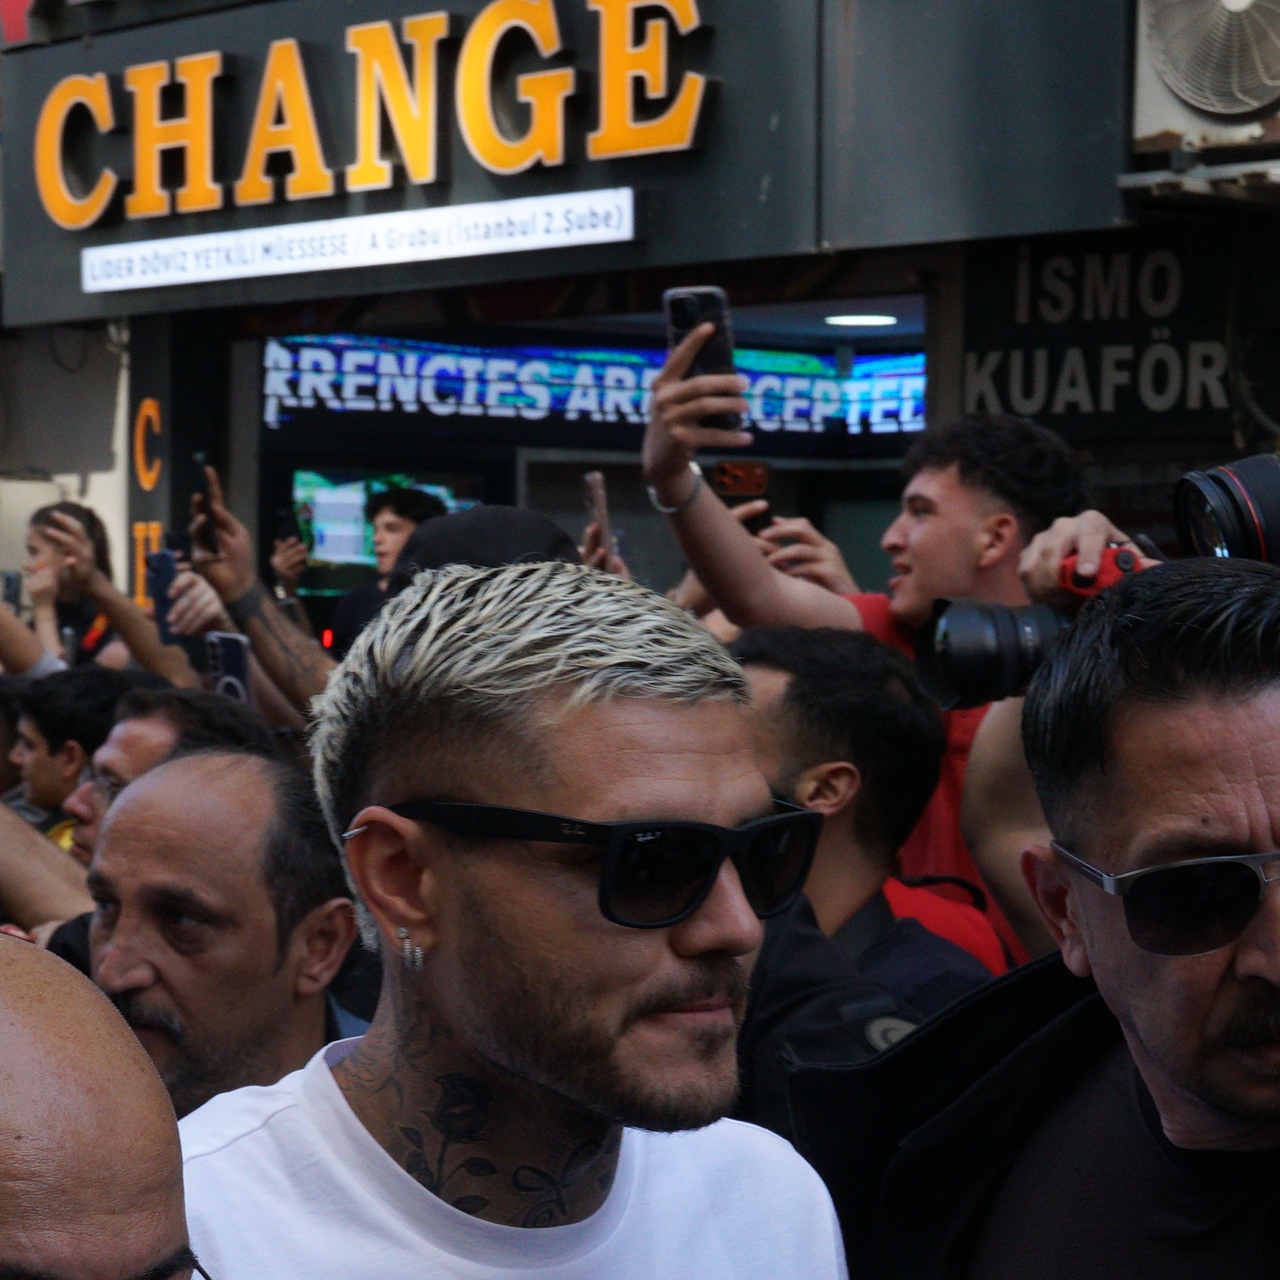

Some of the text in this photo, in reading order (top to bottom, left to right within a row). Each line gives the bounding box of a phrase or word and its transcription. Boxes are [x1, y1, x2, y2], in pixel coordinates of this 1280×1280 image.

[34, 0, 705, 231] CHANGE
[1015, 247, 1182, 324] İSMO
[964, 326, 1230, 416] KUAFÖR
